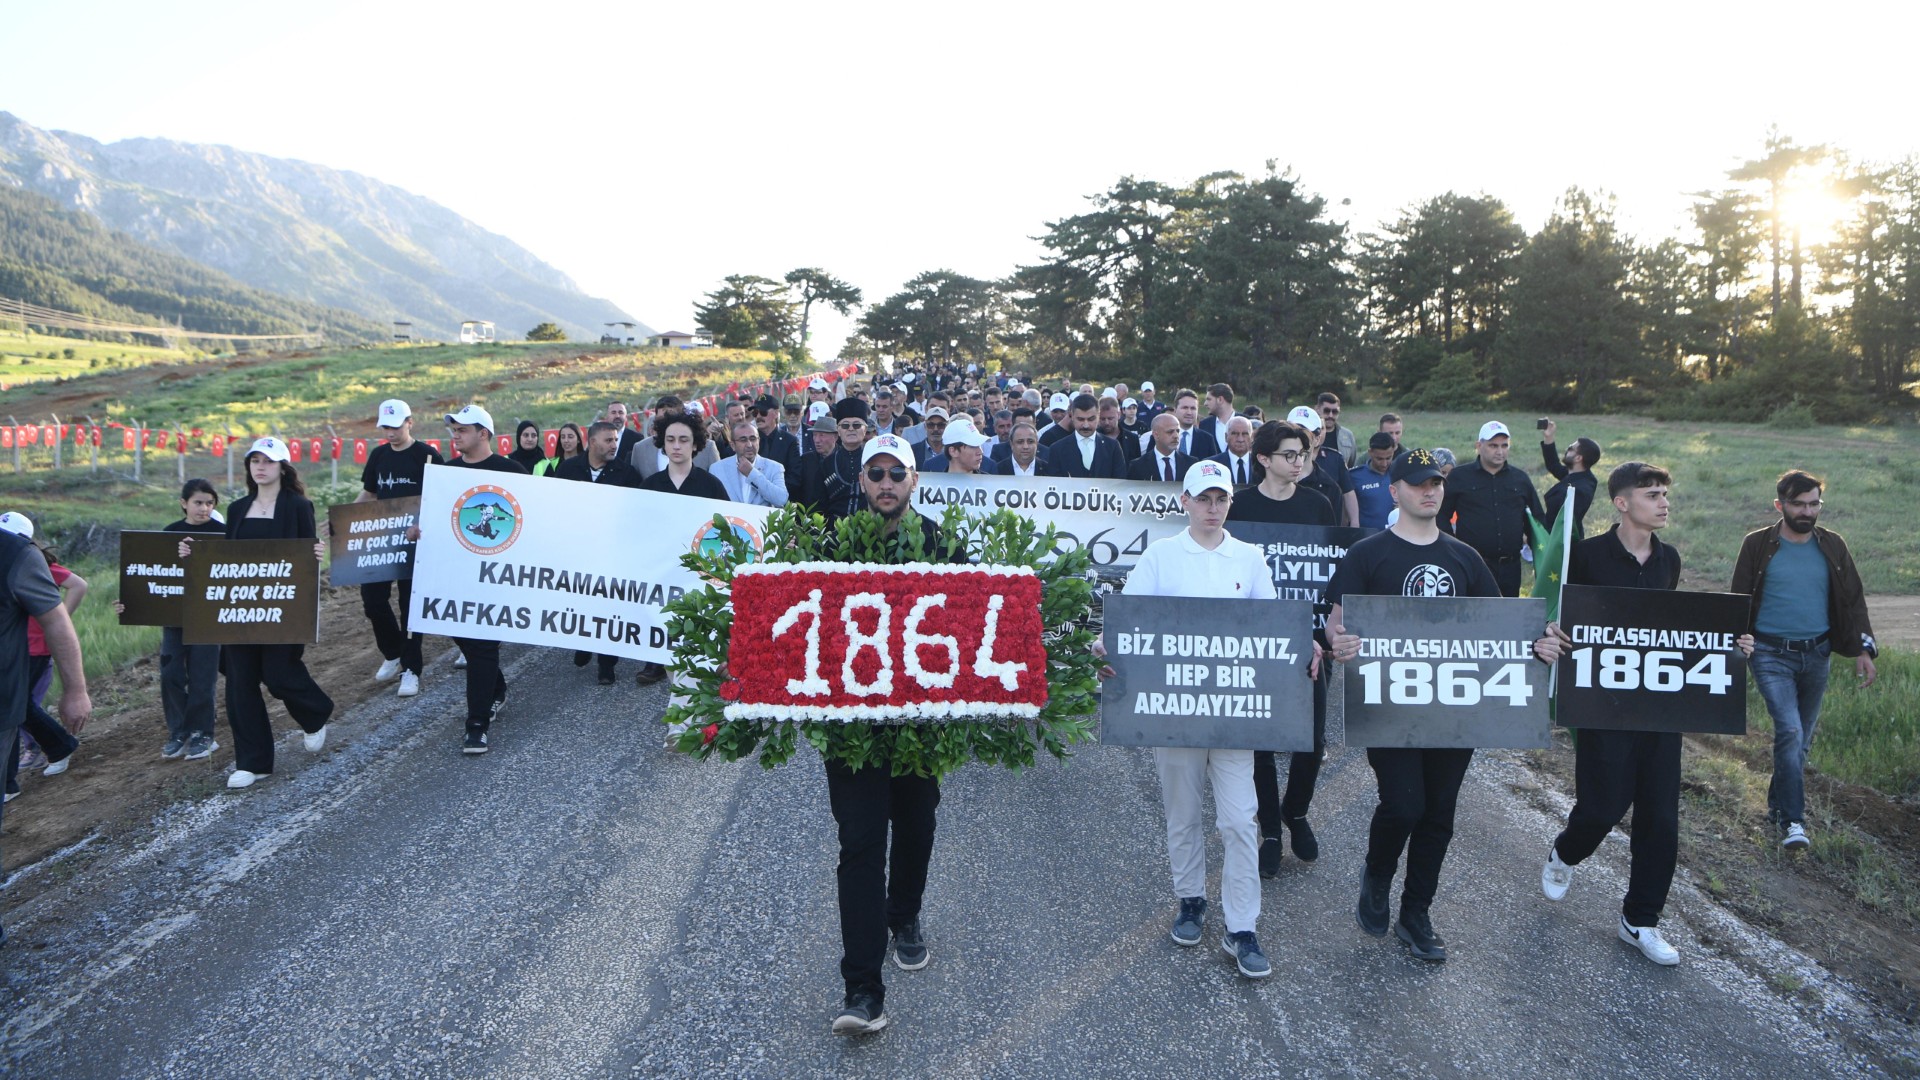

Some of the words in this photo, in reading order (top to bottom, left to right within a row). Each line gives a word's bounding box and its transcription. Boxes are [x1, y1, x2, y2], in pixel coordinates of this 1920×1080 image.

[918, 486, 988, 507] KADAR
[1044, 486, 1122, 516] ÖLDÜK;
[1128, 494, 1184, 519] YAŞA
[349, 513, 415, 534] KARADENİZ
[347, 539, 363, 551] EN
[365, 534, 389, 552] ÇOK
[126, 563, 185, 577] #NeKada
[210, 559, 293, 579] KARADENİZ
[357, 551, 408, 568] KARADIR
[206, 585, 225, 600] EN
[230, 585, 259, 604] ÇOK
[262, 582, 297, 600] BİZE
[478, 560, 685, 607] KAHRAMANMAR
[217, 607, 283, 623] KARADIR
[421, 597, 531, 630] KAFKAS
[540, 607, 640, 646] KÜLTÜR
[772, 589, 1027, 697] 1864
[1117, 627, 1156, 656] BİZ
[1162, 634, 1298, 665] BURADAYIZ,
[1358, 638, 1534, 659] CIRCASSIANEXILE
[1571, 624, 1734, 651] CIRCASSIANEXILE
[1165, 664, 1210, 686] HEP
[1216, 659, 1256, 688] BİR
[1359, 661, 1534, 706] 1864
[1571, 646, 1732, 695] 1864
[1134, 692, 1272, 719] ARADAYIZ!!!
